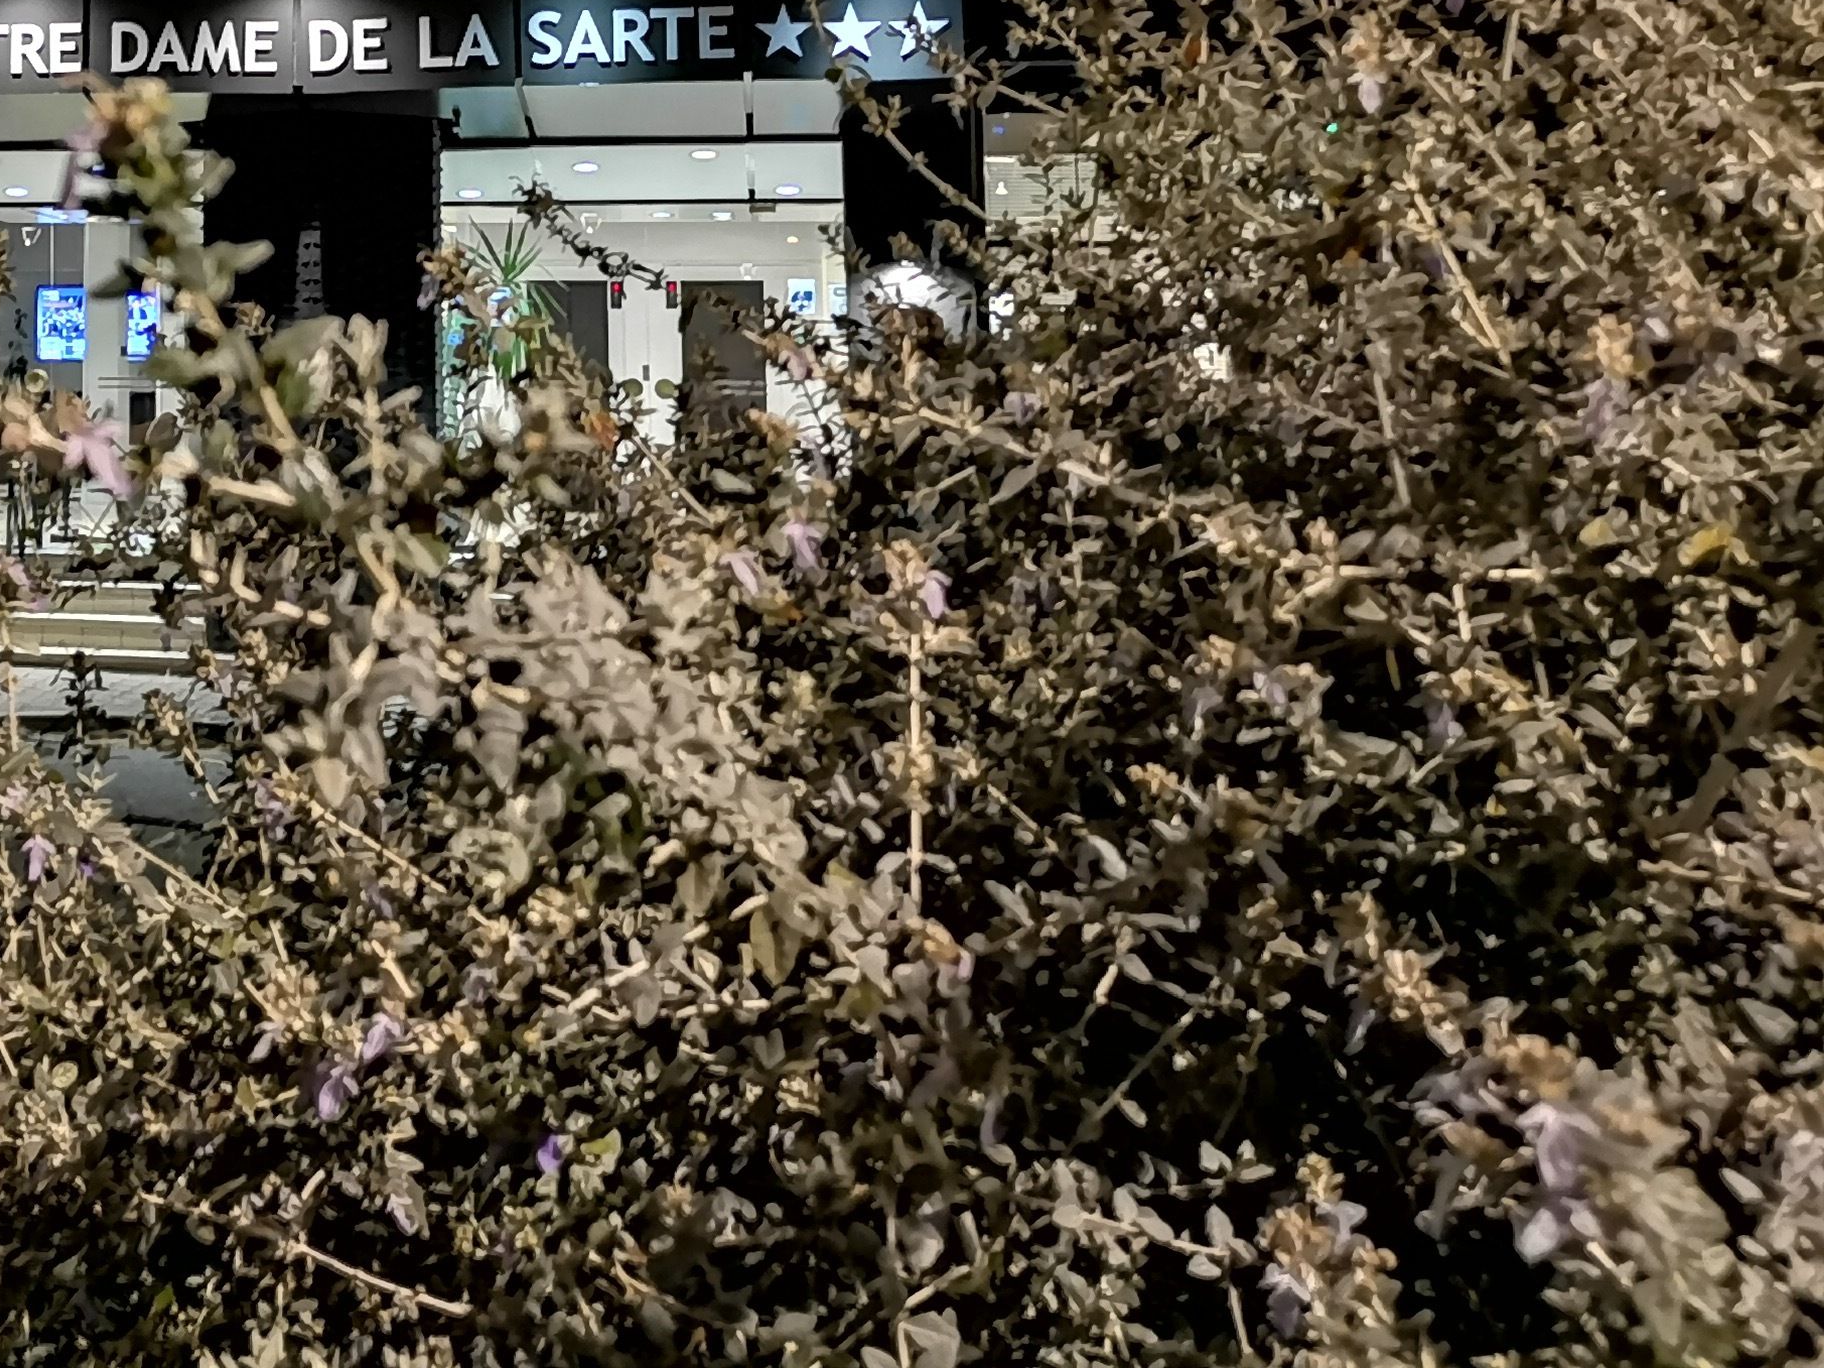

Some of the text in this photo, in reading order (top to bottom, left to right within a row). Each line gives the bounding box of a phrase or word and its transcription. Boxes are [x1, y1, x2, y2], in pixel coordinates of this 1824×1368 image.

[109, 20, 279, 74] DAME
[308, 17, 389, 73] DE
[417, 13, 500, 69] LA
[527, 5, 736, 68] SARTE
